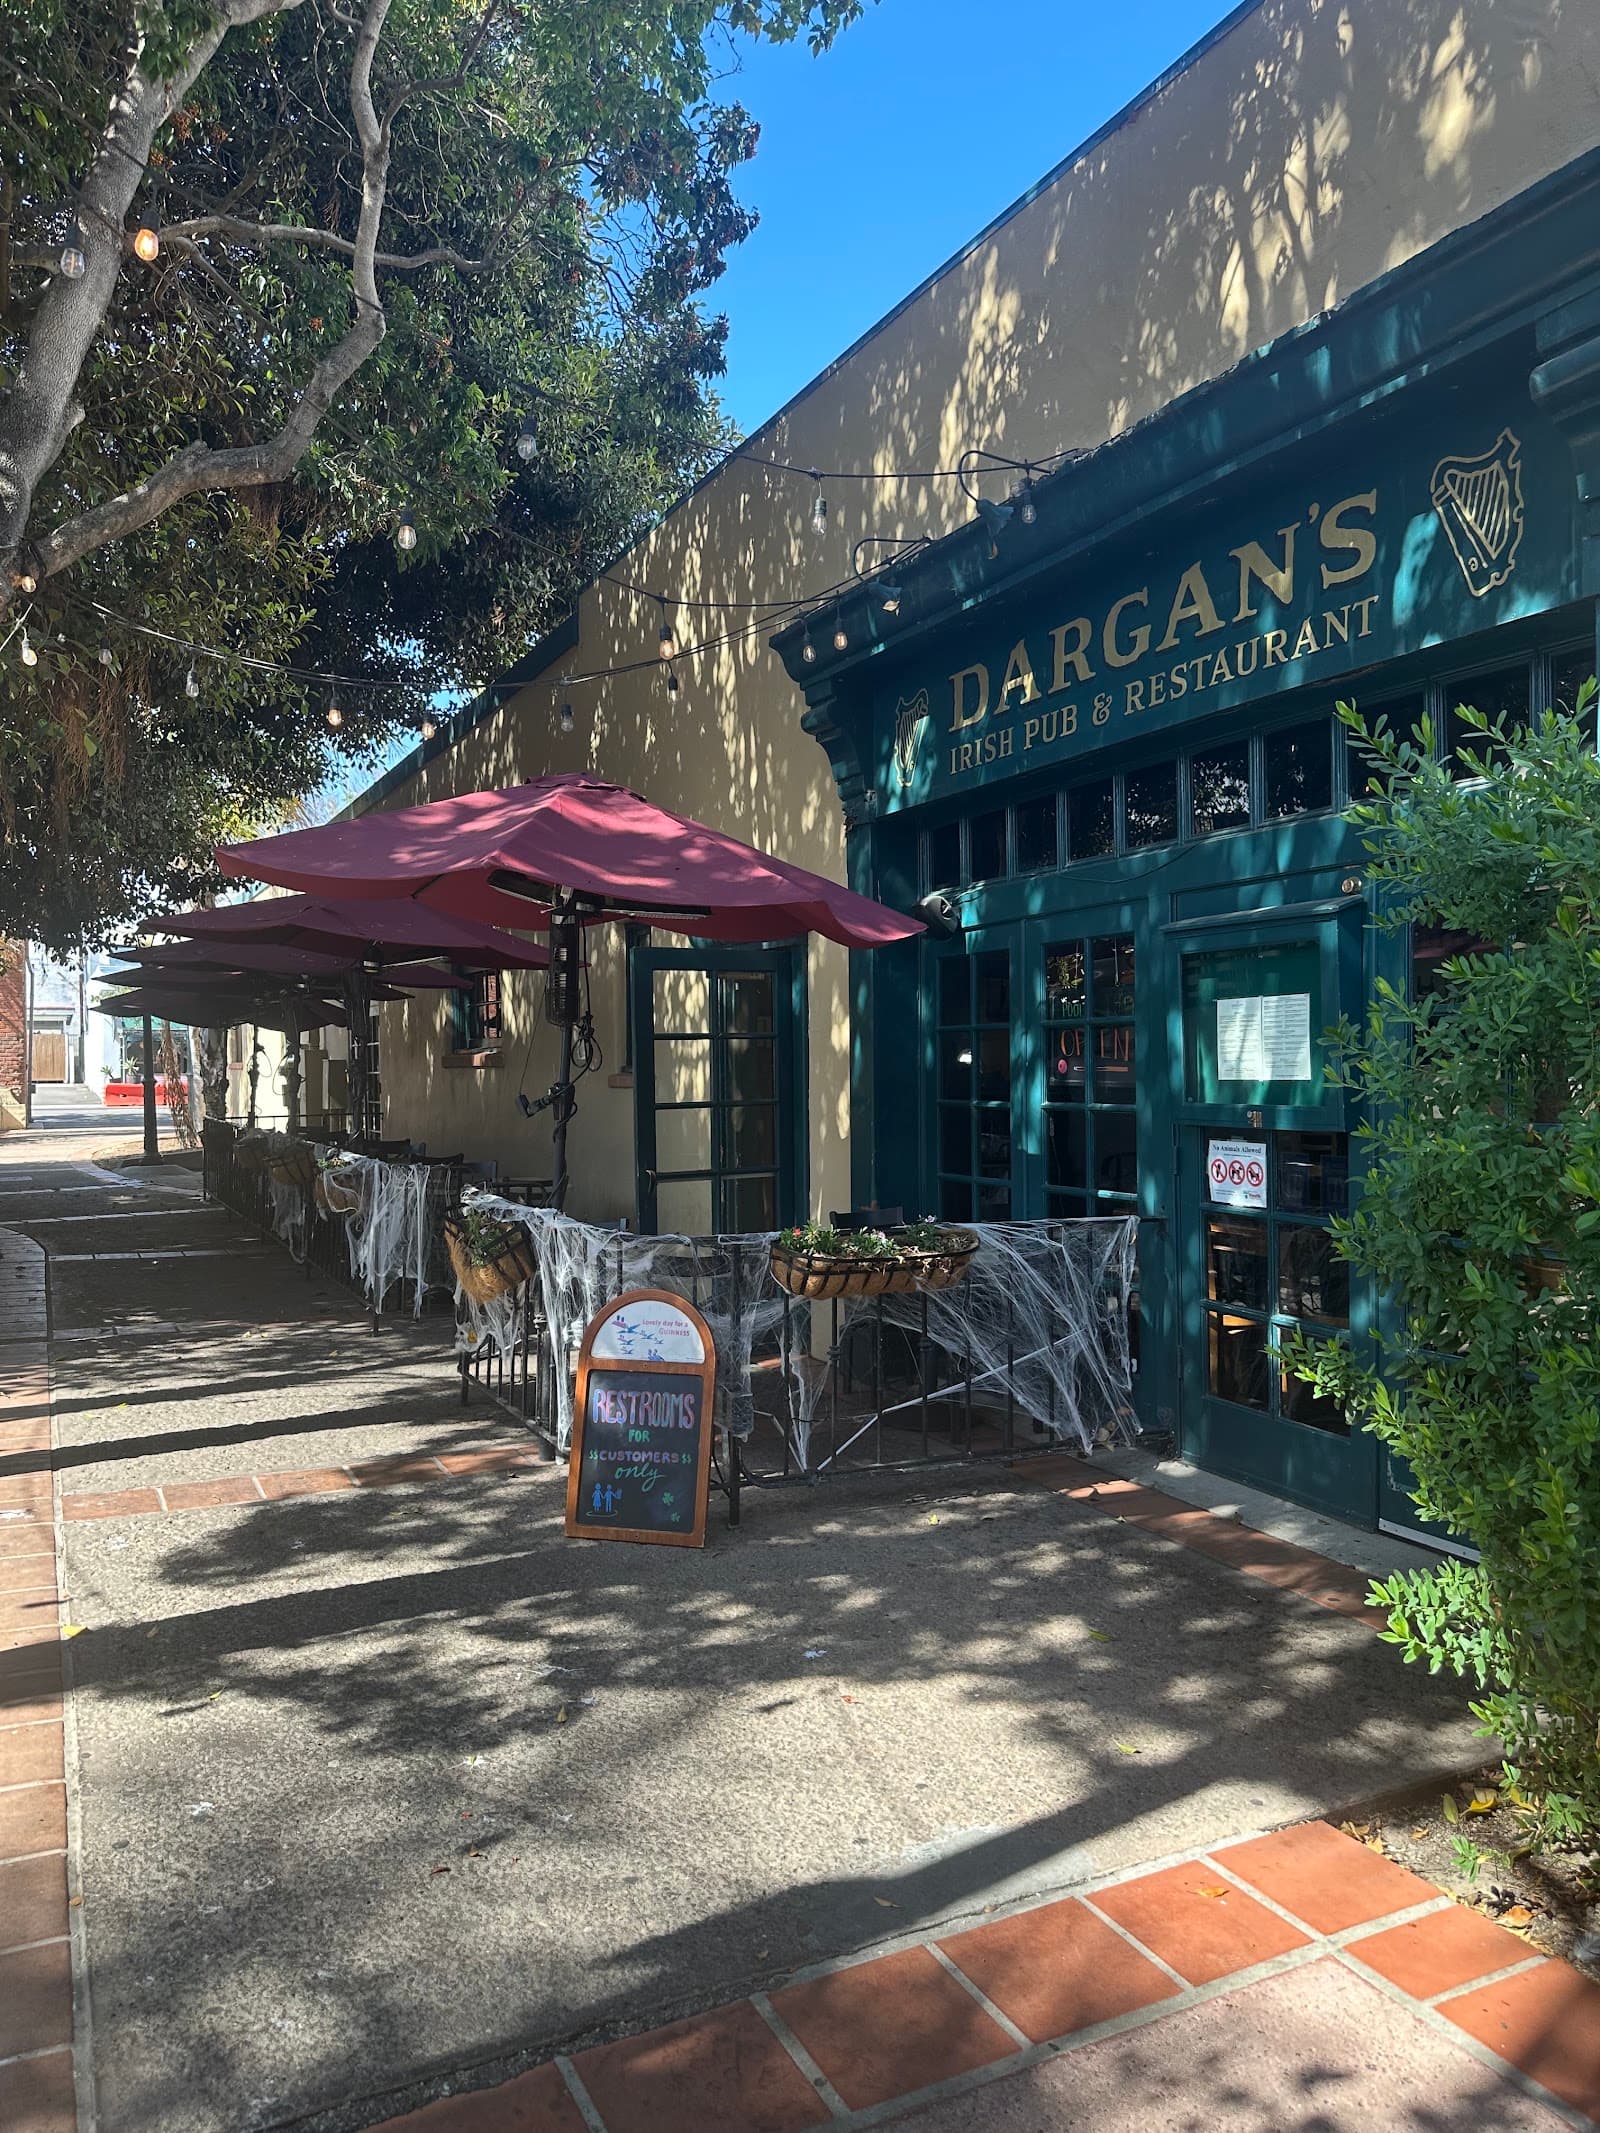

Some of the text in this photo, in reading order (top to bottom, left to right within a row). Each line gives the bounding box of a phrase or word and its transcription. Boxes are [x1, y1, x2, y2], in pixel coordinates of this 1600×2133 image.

[948, 488, 1377, 733] DARGAN'S
[949, 595, 1380, 775] IRISH PUB & RESTAURANT
[1220, 1145, 1240, 1153] Animals
[1241, 1146, 1262, 1154] Allowed
[642, 1319, 662, 1327] Lovely
[674, 1319, 683, 1327] for
[592, 1388, 696, 1430] RESTROOMS
[628, 1429, 651, 1443] FOR
[599, 1450, 680, 1464] CUSTOMERS
[614, 1462, 666, 1493] only
